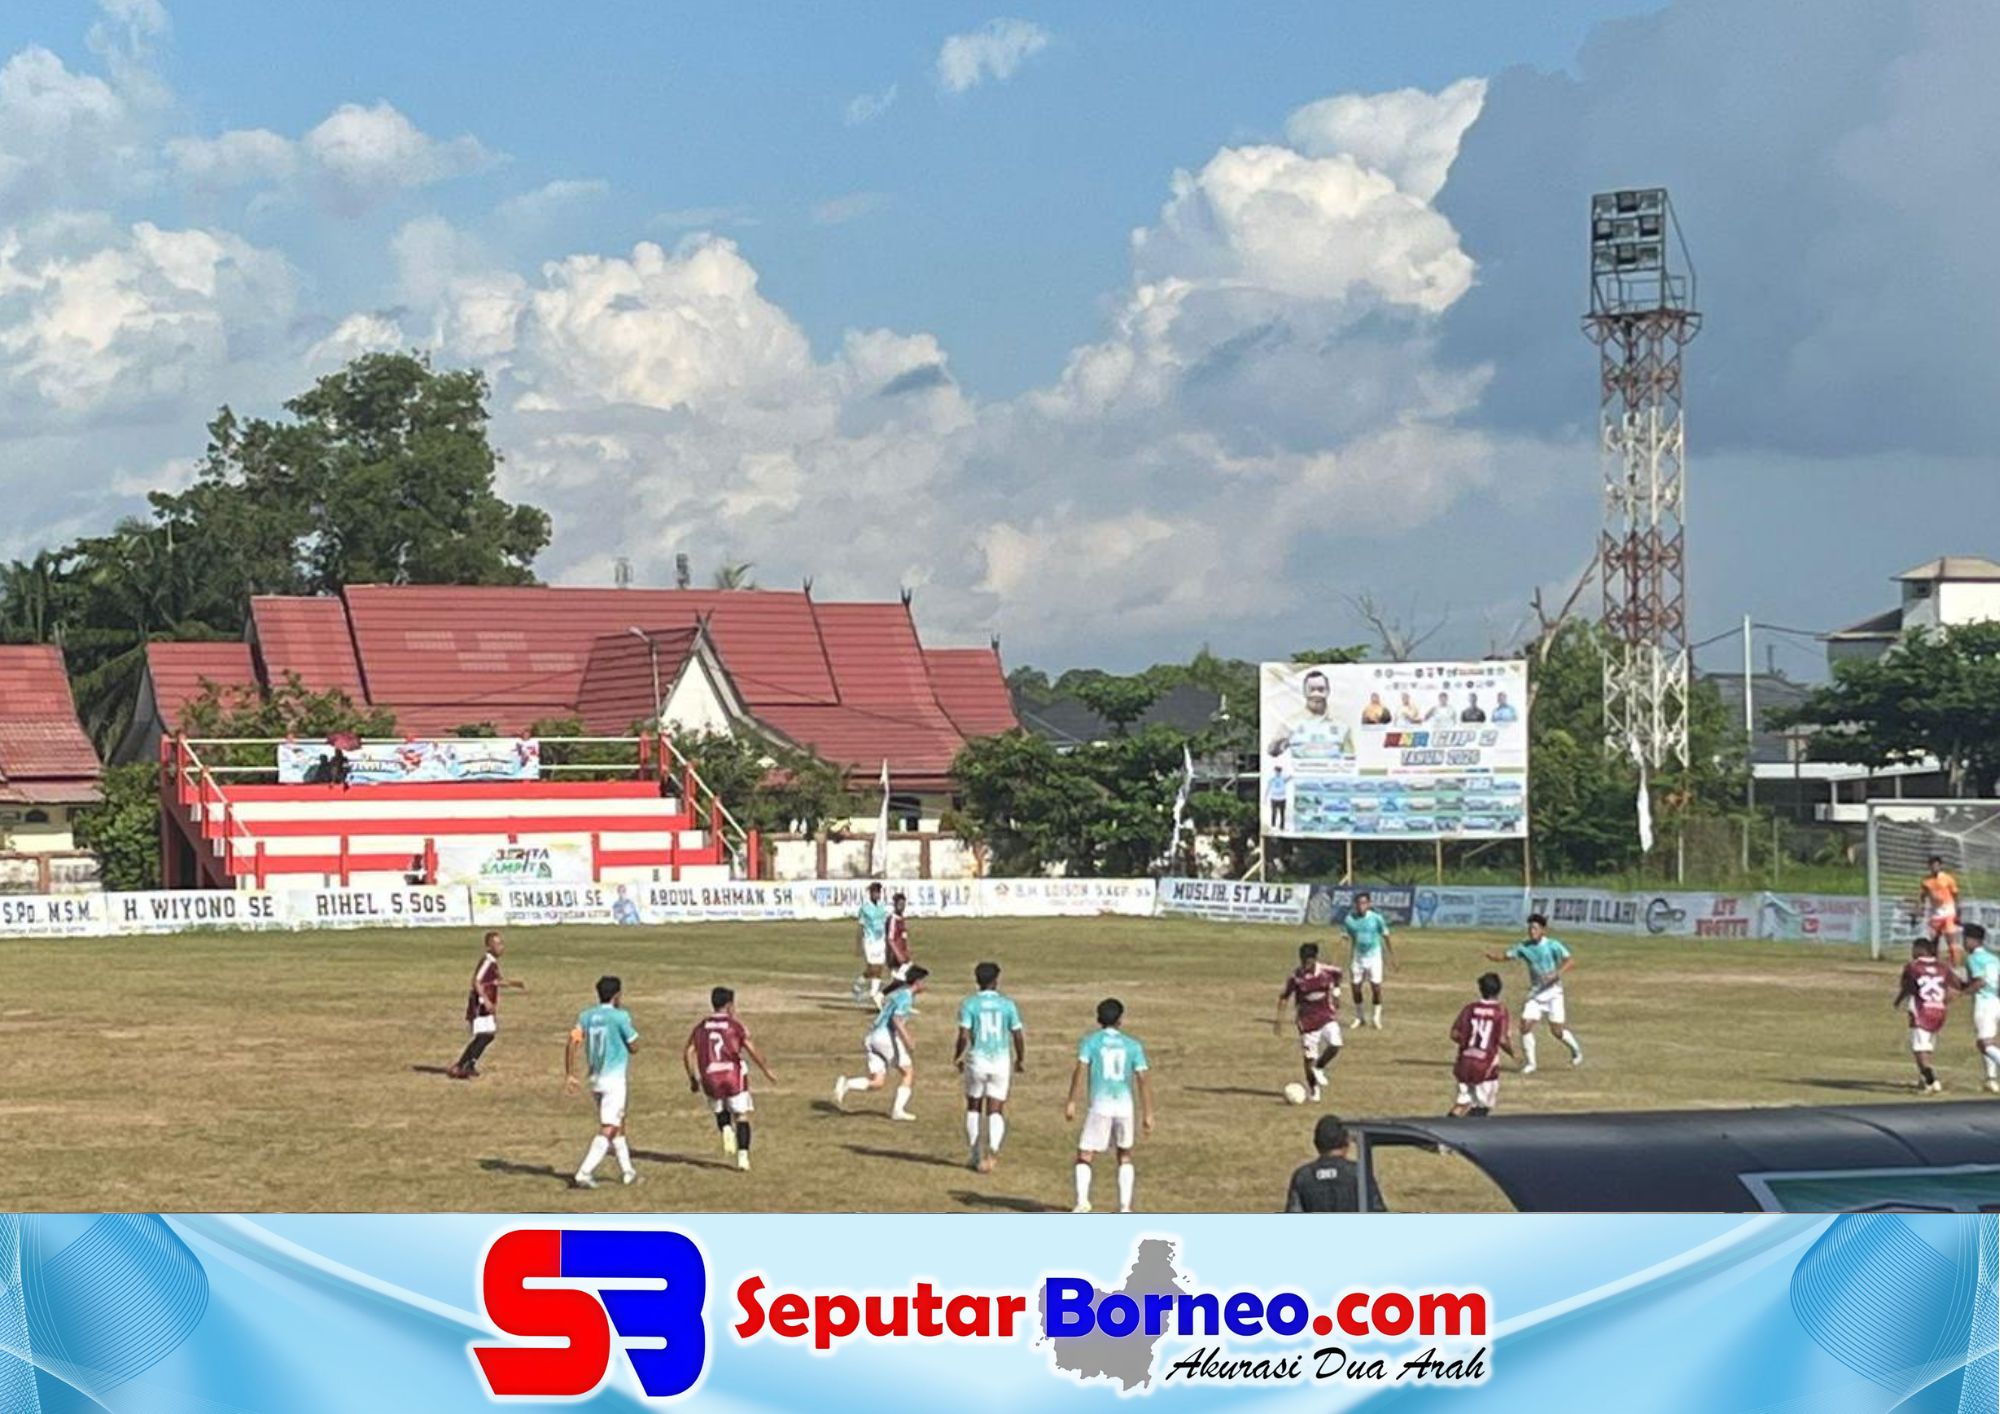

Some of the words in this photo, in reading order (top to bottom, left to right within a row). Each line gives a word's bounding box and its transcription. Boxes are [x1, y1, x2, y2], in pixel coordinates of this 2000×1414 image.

[1432, 730, 1476, 748] CUP
[1402, 749, 1445, 766] TAHUN
[249, 896, 275, 918] SE
[650, 888, 698, 906] ABDUL
[979, 1010, 1001, 1042] 14
[1468, 1018, 1494, 1050] 14
[709, 1031, 725, 1061] 7
